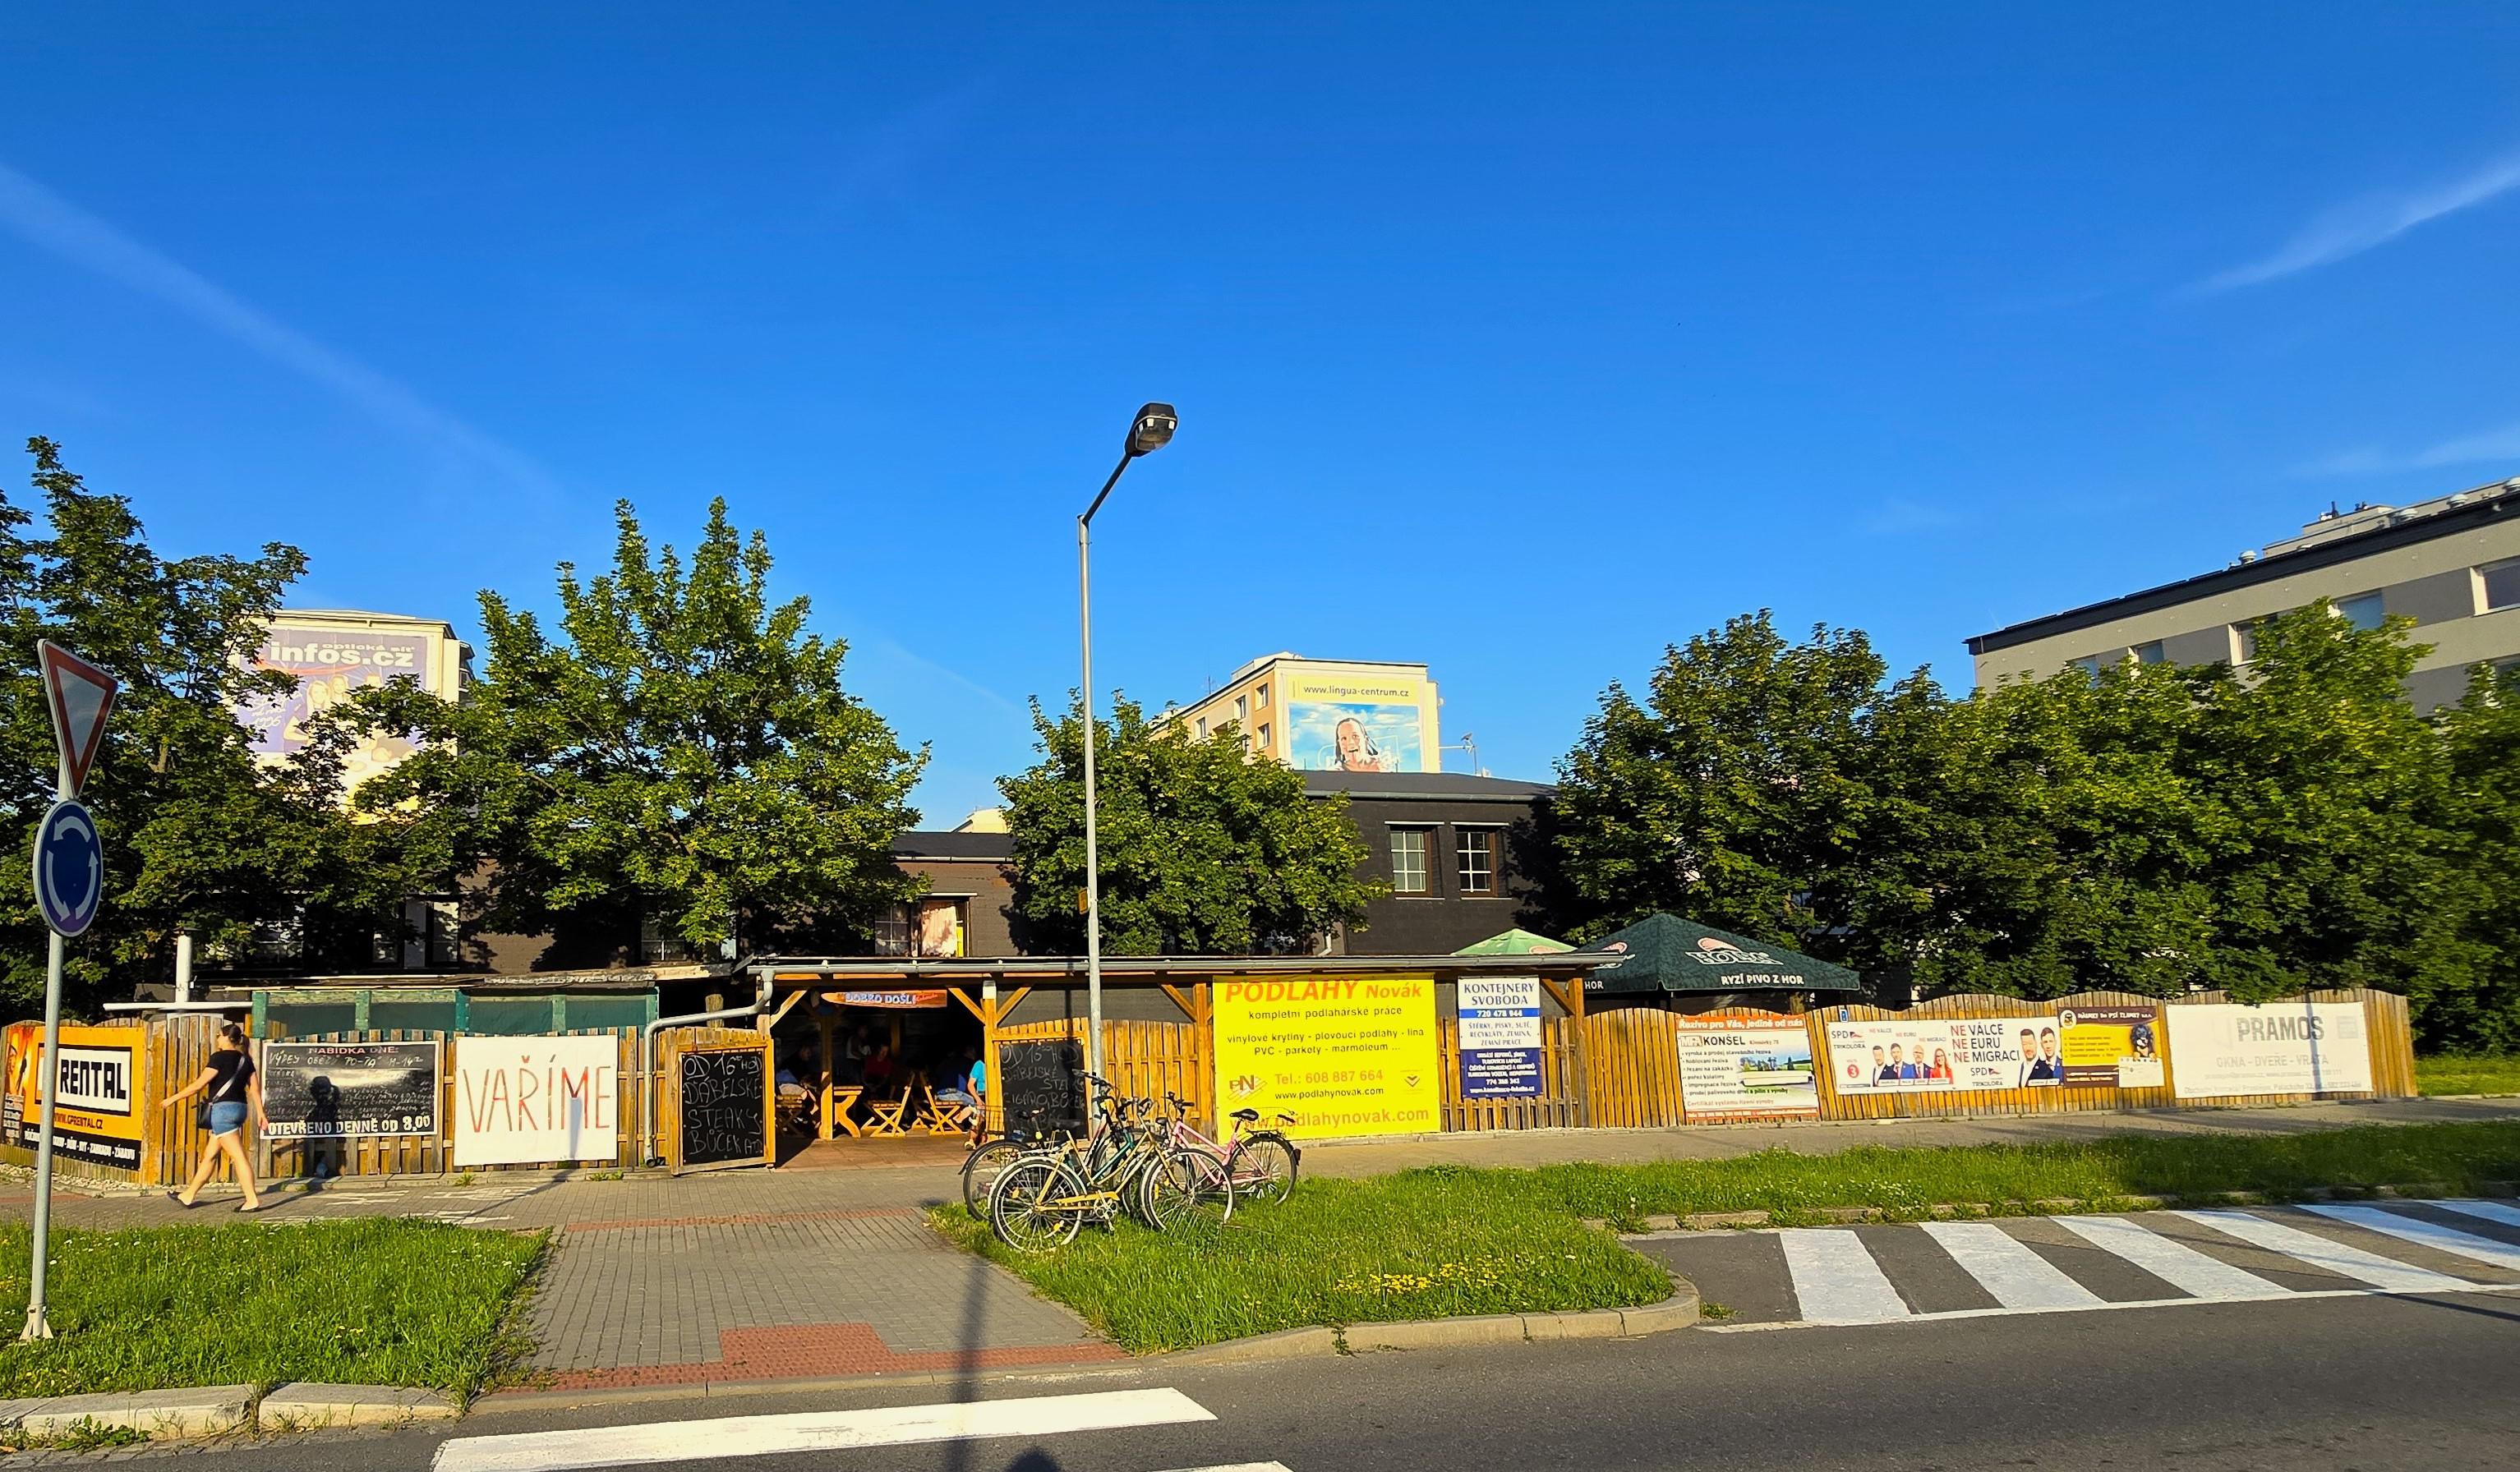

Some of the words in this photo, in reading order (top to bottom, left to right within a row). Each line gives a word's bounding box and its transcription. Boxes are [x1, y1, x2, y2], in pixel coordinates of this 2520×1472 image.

[270, 641, 413, 667] infos.cz
[1303, 685, 1409, 697] www.lingua-centrum.cz
[1584, 980, 1605, 990] HOR
[1721, 973, 1744, 985] RYZÍ
[1747, 974, 1771, 984] PIVO
[1772, 975, 1780, 984] Z
[1781, 975, 1804, 985] HOR
[1225, 978, 1361, 1003] PODLAHY
[1366, 982, 1422, 1000] Novák
[1464, 982, 1535, 995] KONTEJNERY
[1472, 996, 1528, 1005] SVOBODA
[1248, 1010, 1301, 1021] kompletní
[1374, 1006, 1403, 1018] práce
[1709, 1021, 1725, 1029] pro
[1775, 1019, 1786, 1027] od
[1951, 1025, 1966, 1037] NE
[1968, 1022, 2004, 1036] VÁLCE
[2237, 1015, 2325, 1042] PRAMOS
[1227, 1033, 1268, 1044] vinylové
[1272, 1032, 1305, 1043] krytiny
[1315, 1031, 1357, 1042] plovoucí
[1360, 1028, 1398, 1040] podlahy
[1407, 1028, 1425, 1037] lina
[1703, 1033, 1746, 1046] KONŠEL
[1831, 1030, 1849, 1039] SPD
[1254, 1046, 1274, 1056] PVC
[1285, 1046, 1321, 1056] parkety
[1332, 1043, 1389, 1053] marmoleum
[1952, 1038, 1969, 1050] NE
[1970, 1037, 2001, 1050] EURU
[308, 1046, 366, 1055] NABÍDKA
[1954, 1051, 1970, 1063] NE
[1972, 1050, 2020, 1063] MIGRACI
[2216, 1055, 2246, 1069] OKNA
[2255, 1052, 2288, 1067] DVEŘE
[2296, 1053, 2329, 1066] VRATA
[684, 1055, 711, 1081] OD
[1850, 1066, 1857, 1076] 3
[1970, 1067, 1988, 1077] SPD
[60, 1059, 127, 1100] RENTAL
[1274, 1073, 1301, 1085] Tel.:
[1305, 1072, 1329, 1083] 608
[1333, 1071, 1356, 1083] 887
[1360, 1070, 1384, 1082] 664
[462, 1054, 611, 1133] VAŘÍME
[1274, 1087, 1384, 1101] www.podlahynovak.com
[268, 1117, 332, 1135] OTEVŘENO
[335, 1117, 379, 1134] DENNĚ
[381, 1120, 399, 1132] OD
[402, 1115, 431, 1132] 8.00
